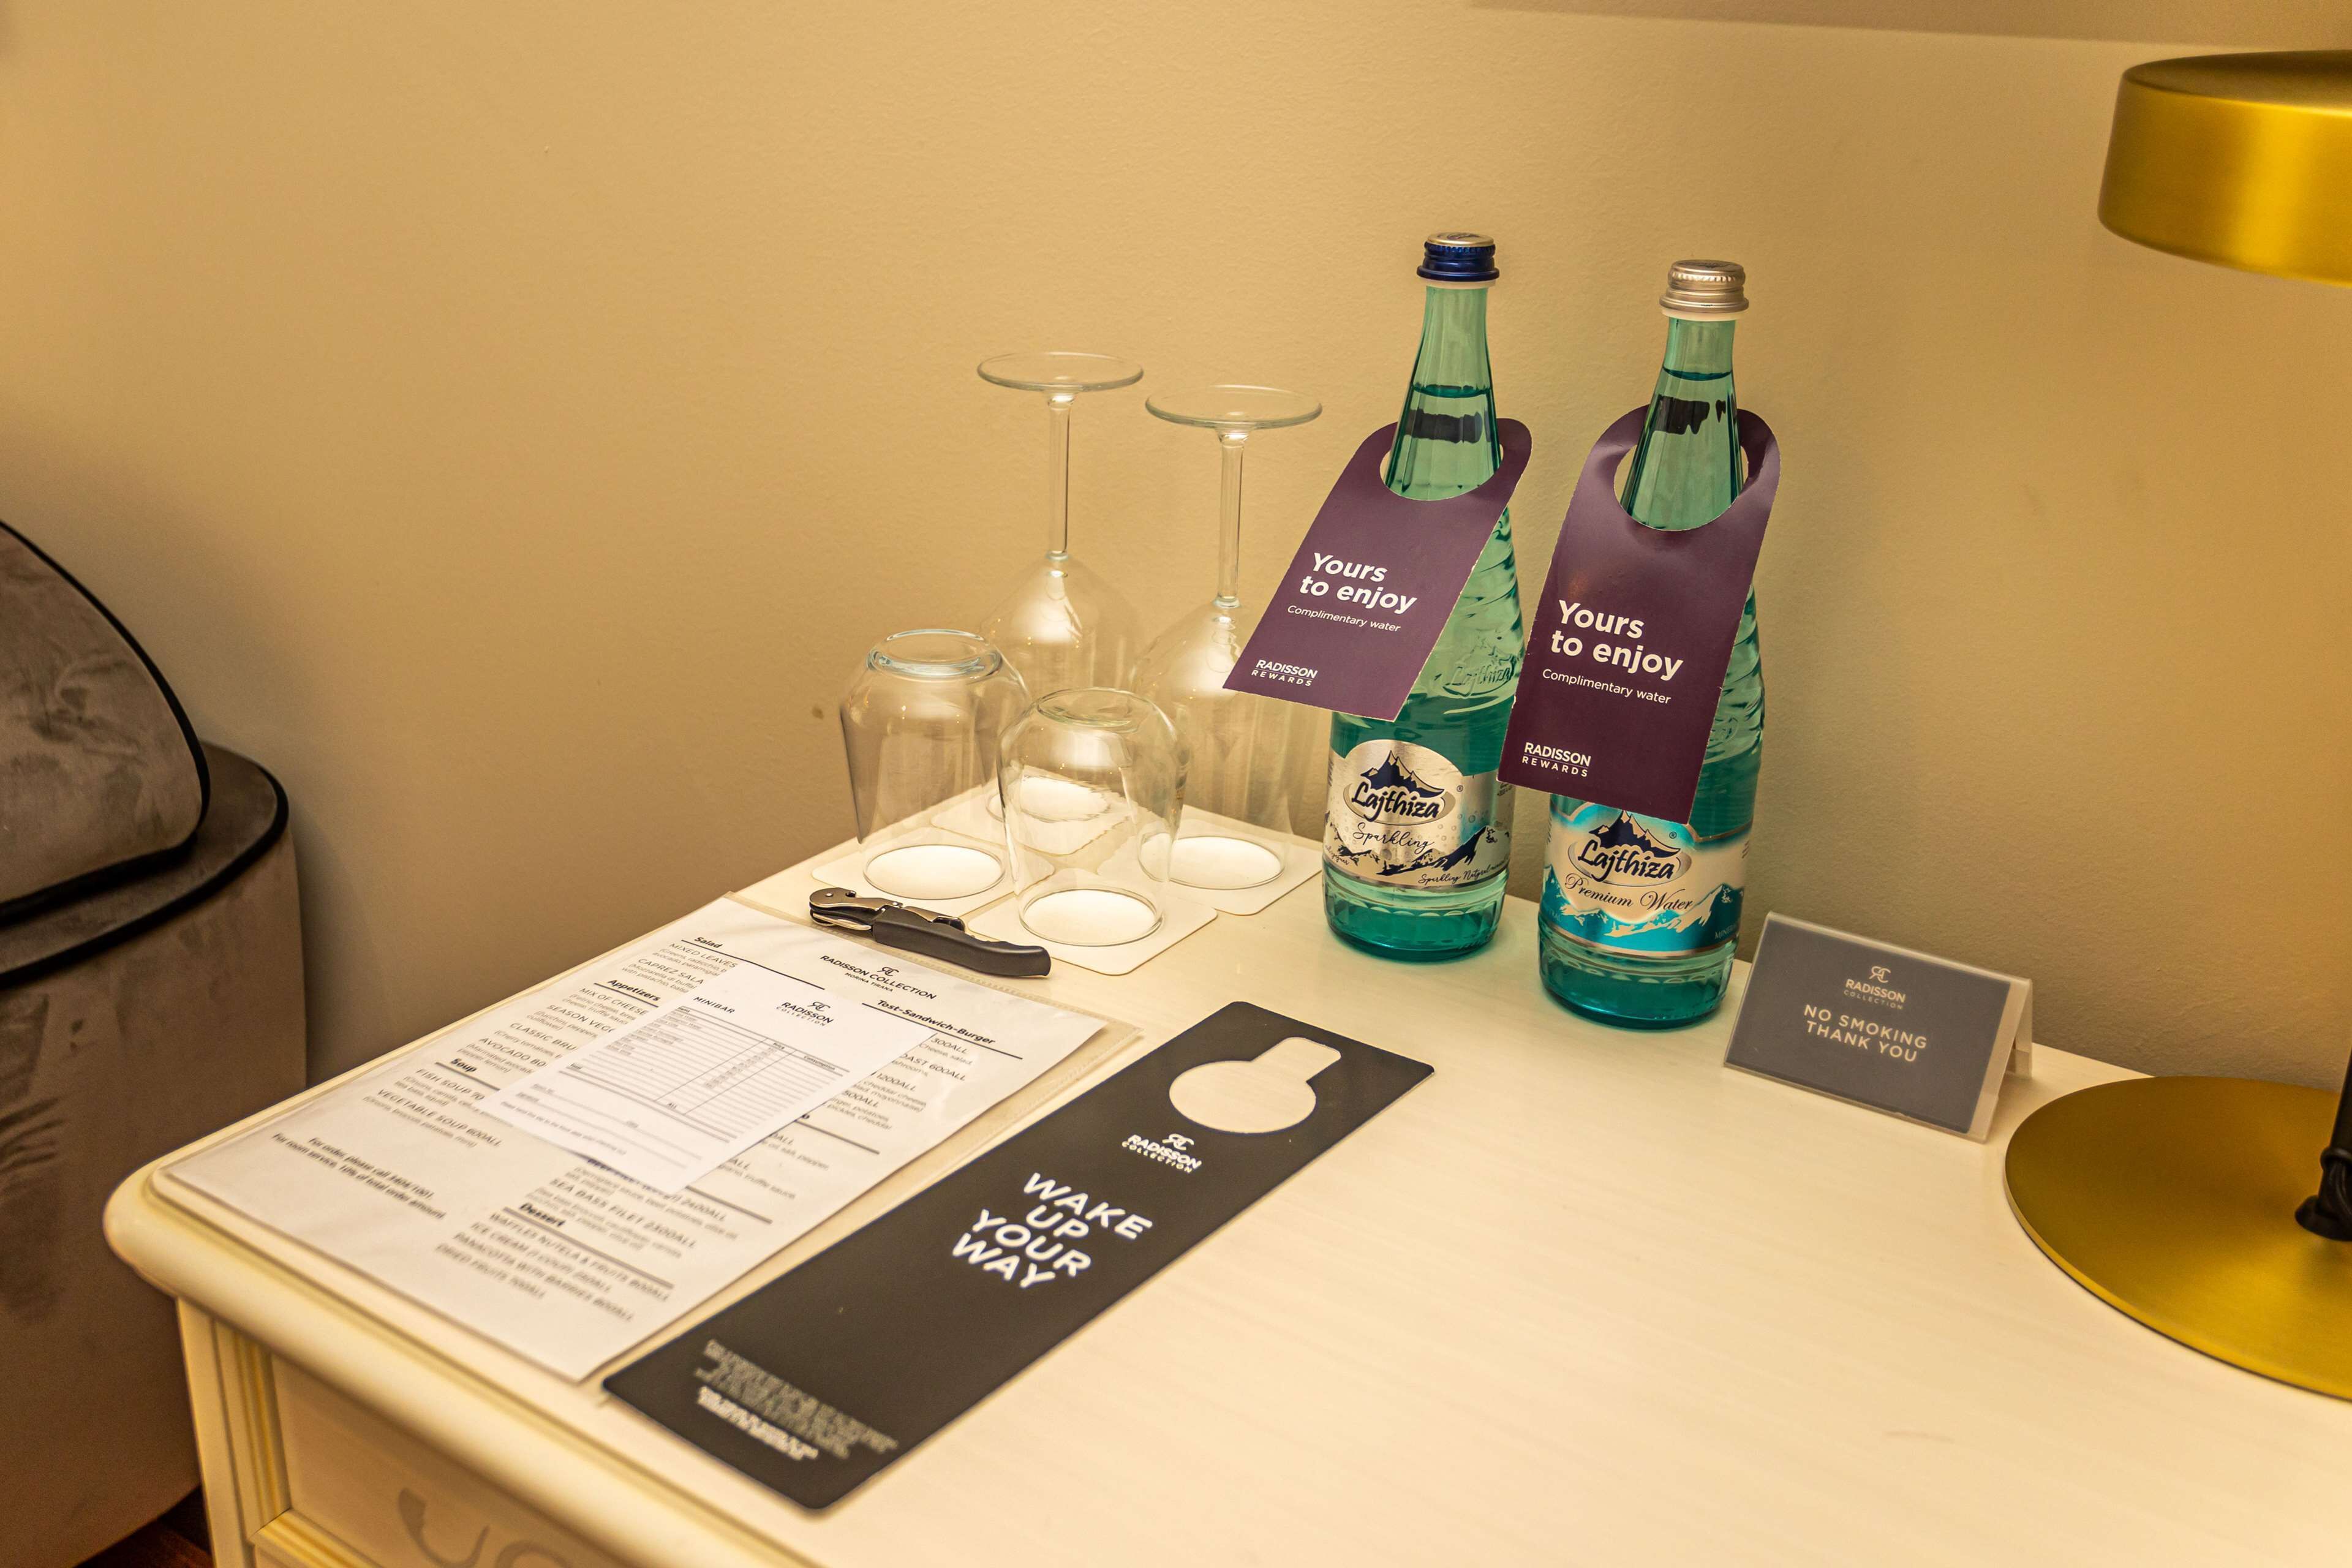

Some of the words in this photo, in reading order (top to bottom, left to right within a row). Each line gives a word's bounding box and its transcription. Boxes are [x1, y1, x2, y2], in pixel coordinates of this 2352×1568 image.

[1313, 552, 1388, 582] Yours
[1300, 576, 1329, 596] to
[1336, 586, 1417, 614] enjoy
[1287, 605, 1366, 627] Complimentary
[1370, 620, 1401, 632] water
[1559, 600, 1645, 638] Yours
[1256, 660, 1317, 679] RADISSON
[1551, 630, 1583, 656] to
[1593, 644, 1683, 681] enjoy
[1251, 670, 1313, 687] REWARDS
[1542, 669, 1632, 697] Complimentary
[1637, 690, 1672, 704] water
[1522, 756, 1588, 777] REWARDS
[1524, 742, 1591, 766] RADISSON
[1351, 782, 1440, 822] Lajthiza
[1352, 822, 1434, 854] Sparkling
[1577, 840, 1675, 882] Lajthiza
[1564, 873, 1632, 908] Premium
[1640, 889, 1693, 911] Water
[668, 943, 701, 956] MIXED
[700, 954, 737, 968] LEAVES
[695, 937, 723, 948] Salad
[638, 959, 678, 974] CAPREZ
[820, 955, 870, 976] RADISSON
[870, 974, 937, 1000] COLLECTION
[579, 987, 597, 997] MIX
[608, 979, 661, 1001] Appetizers
[1844, 989, 1903, 1009] COLLECTION
[1845, 979, 1905, 1003] RADISSON
[546, 1005, 589, 1022] SEASON
[693, 996, 735, 1014] MINIBAR
[782, 1002, 834, 1023] RADISSON
[510, 1022, 553, 1041] CLASSIC
[877, 1000, 995, 1044] Tost-Sandwich-Burger
[1804, 1005, 1831, 1022] NO
[1839, 1015, 1927, 1049] SMOKING
[478, 1038, 531, 1061] AVOCADO
[1806, 1020, 1870, 1050] THANK
[1879, 1043, 1918, 1062] YOU
[450, 1058, 477, 1072] Soup
[1122, 1140, 1192, 1173] COLLECTION
[1128, 1134, 1202, 1169] RADISSON
[519, 1202, 565, 1227] Dessert
[1023, 1172, 1153, 1240] WAKE
[1026, 1205, 1089, 1237] UP
[972, 1209, 1091, 1276] YOUR
[952, 1232, 1055, 1287] WAY
